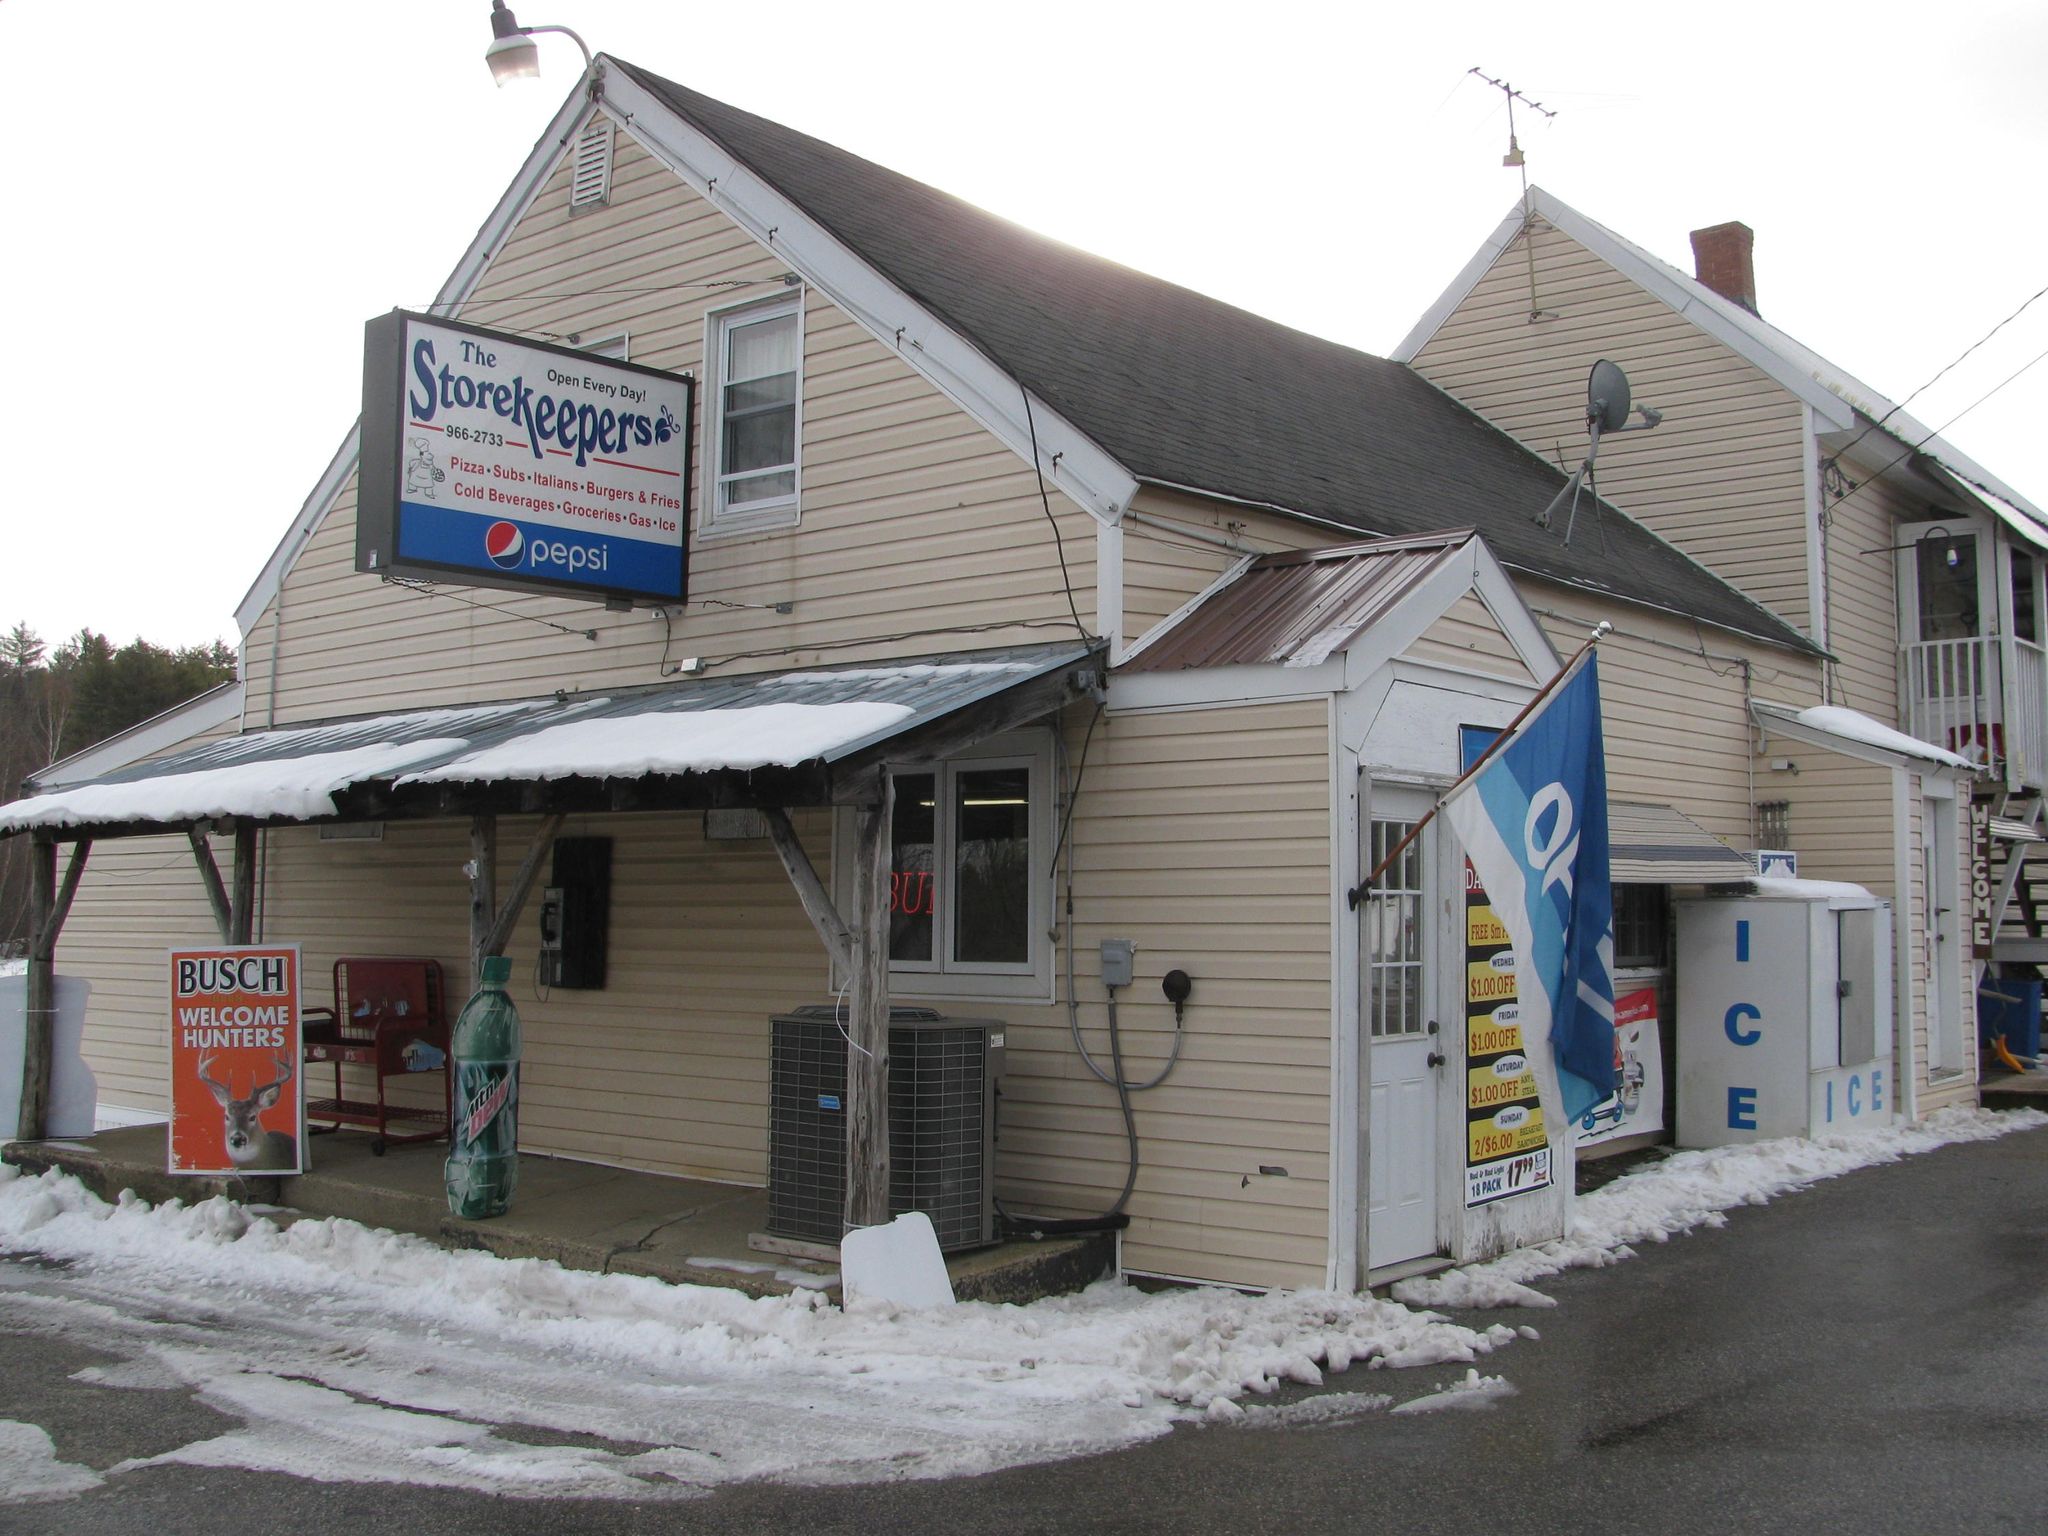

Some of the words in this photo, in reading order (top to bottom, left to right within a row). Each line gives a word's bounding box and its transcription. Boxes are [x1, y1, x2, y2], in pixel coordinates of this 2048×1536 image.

[460, 339, 497, 368] The
[547, 369, 580, 388] Open
[583, 377, 617, 399] Every
[620, 386, 647, 403] Day!
[410, 339, 653, 467] Storekeepers
[446, 425, 504, 447] 966-2733
[450, 456, 485, 475] Pizza
[493, 464, 525, 482] Subs
[533, 472, 578, 492] Italians
[586, 481, 634, 503] Burgers
[639, 490, 647, 504] &
[651, 492, 680, 510] Fries
[454, 482, 484, 500] Cold
[489, 488, 555, 512] Beverages
[563, 501, 622, 523] Groceries
[628, 512, 651, 528] Gas
[659, 516, 676, 532] Ice
[531, 539, 608, 573] pepsi
[1970, 804, 1991, 945] WELCOME
[1471, 924, 1488, 940] FREE
[178, 957, 289, 997] BUSCH
[1471, 977, 1495, 999] $1.00
[1497, 975, 1516, 994] OFF
[179, 1006, 289, 1026] WELCOME
[1498, 1010, 1519, 1020] FRIDAY
[1724, 920, 1762, 1130] ICE
[184, 1027, 285, 1048] HUNTERS
[1471, 1031, 1497, 1053] $1.00
[1499, 1028, 1517, 1048] OFF
[1496, 1061, 1524, 1073] SATURDAY
[1471, 1084, 1498, 1107] $1.00
[1500, 1080, 1519, 1099] OFF
[1826, 1070, 1882, 1123] ICE
[1500, 1112, 1522, 1125] SUNDAY
[1475, 1132, 1513, 1156] 2/$6.00
[1472, 1183, 1481, 1197] 18
[1482, 1178, 1502, 1194] PACK
